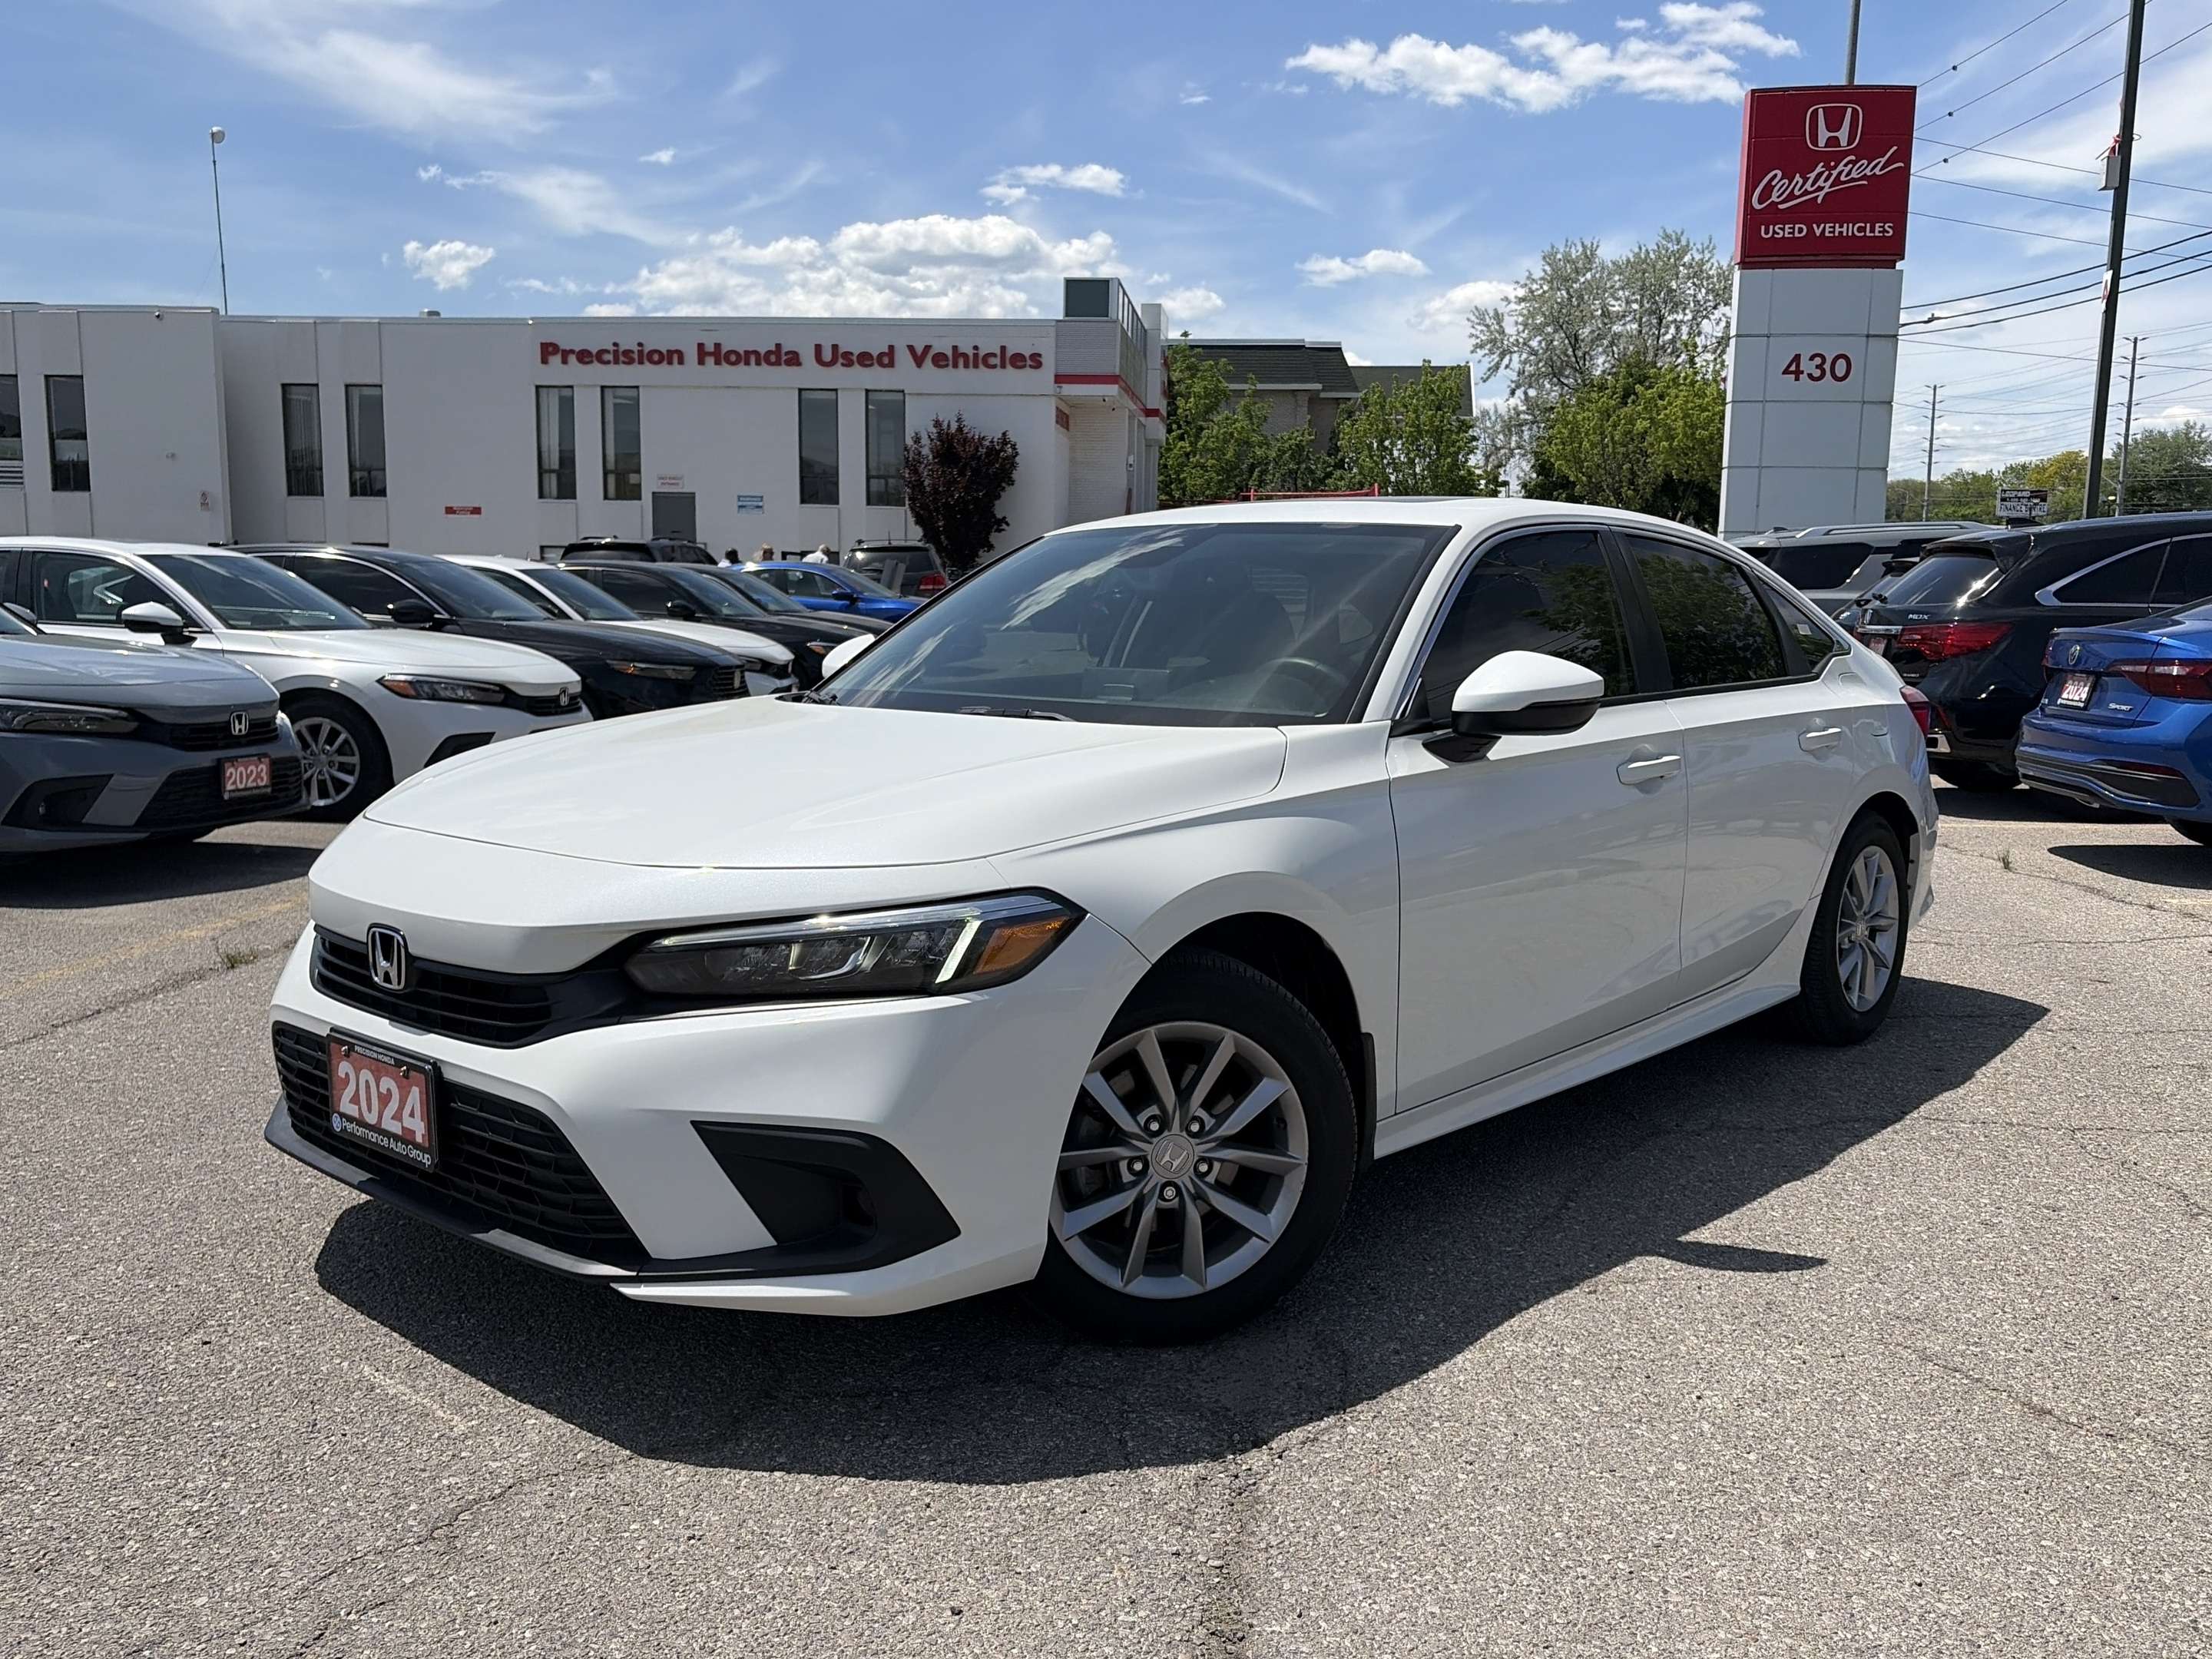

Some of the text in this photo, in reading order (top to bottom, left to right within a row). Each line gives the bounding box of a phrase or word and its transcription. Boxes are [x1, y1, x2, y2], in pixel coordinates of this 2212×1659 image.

[1752, 146, 1904, 210] Certified
[1761, 223, 1893, 238] USED VEHICLES
[540, 342, 1043, 369] Precision Honda Used Vehicles
[1782, 353, 1852, 382] 430
[2000, 503, 2023, 512] FINANCE
[2061, 680, 2090, 701] 2024
[2108, 703, 2133, 711] SPORT
[226, 764, 267, 790] 2023
[354, 1045, 395, 1066] PRECISION HONDA
[338, 1061, 425, 1143] 2024
[343, 1118, 431, 1167] Performance Auto Group
